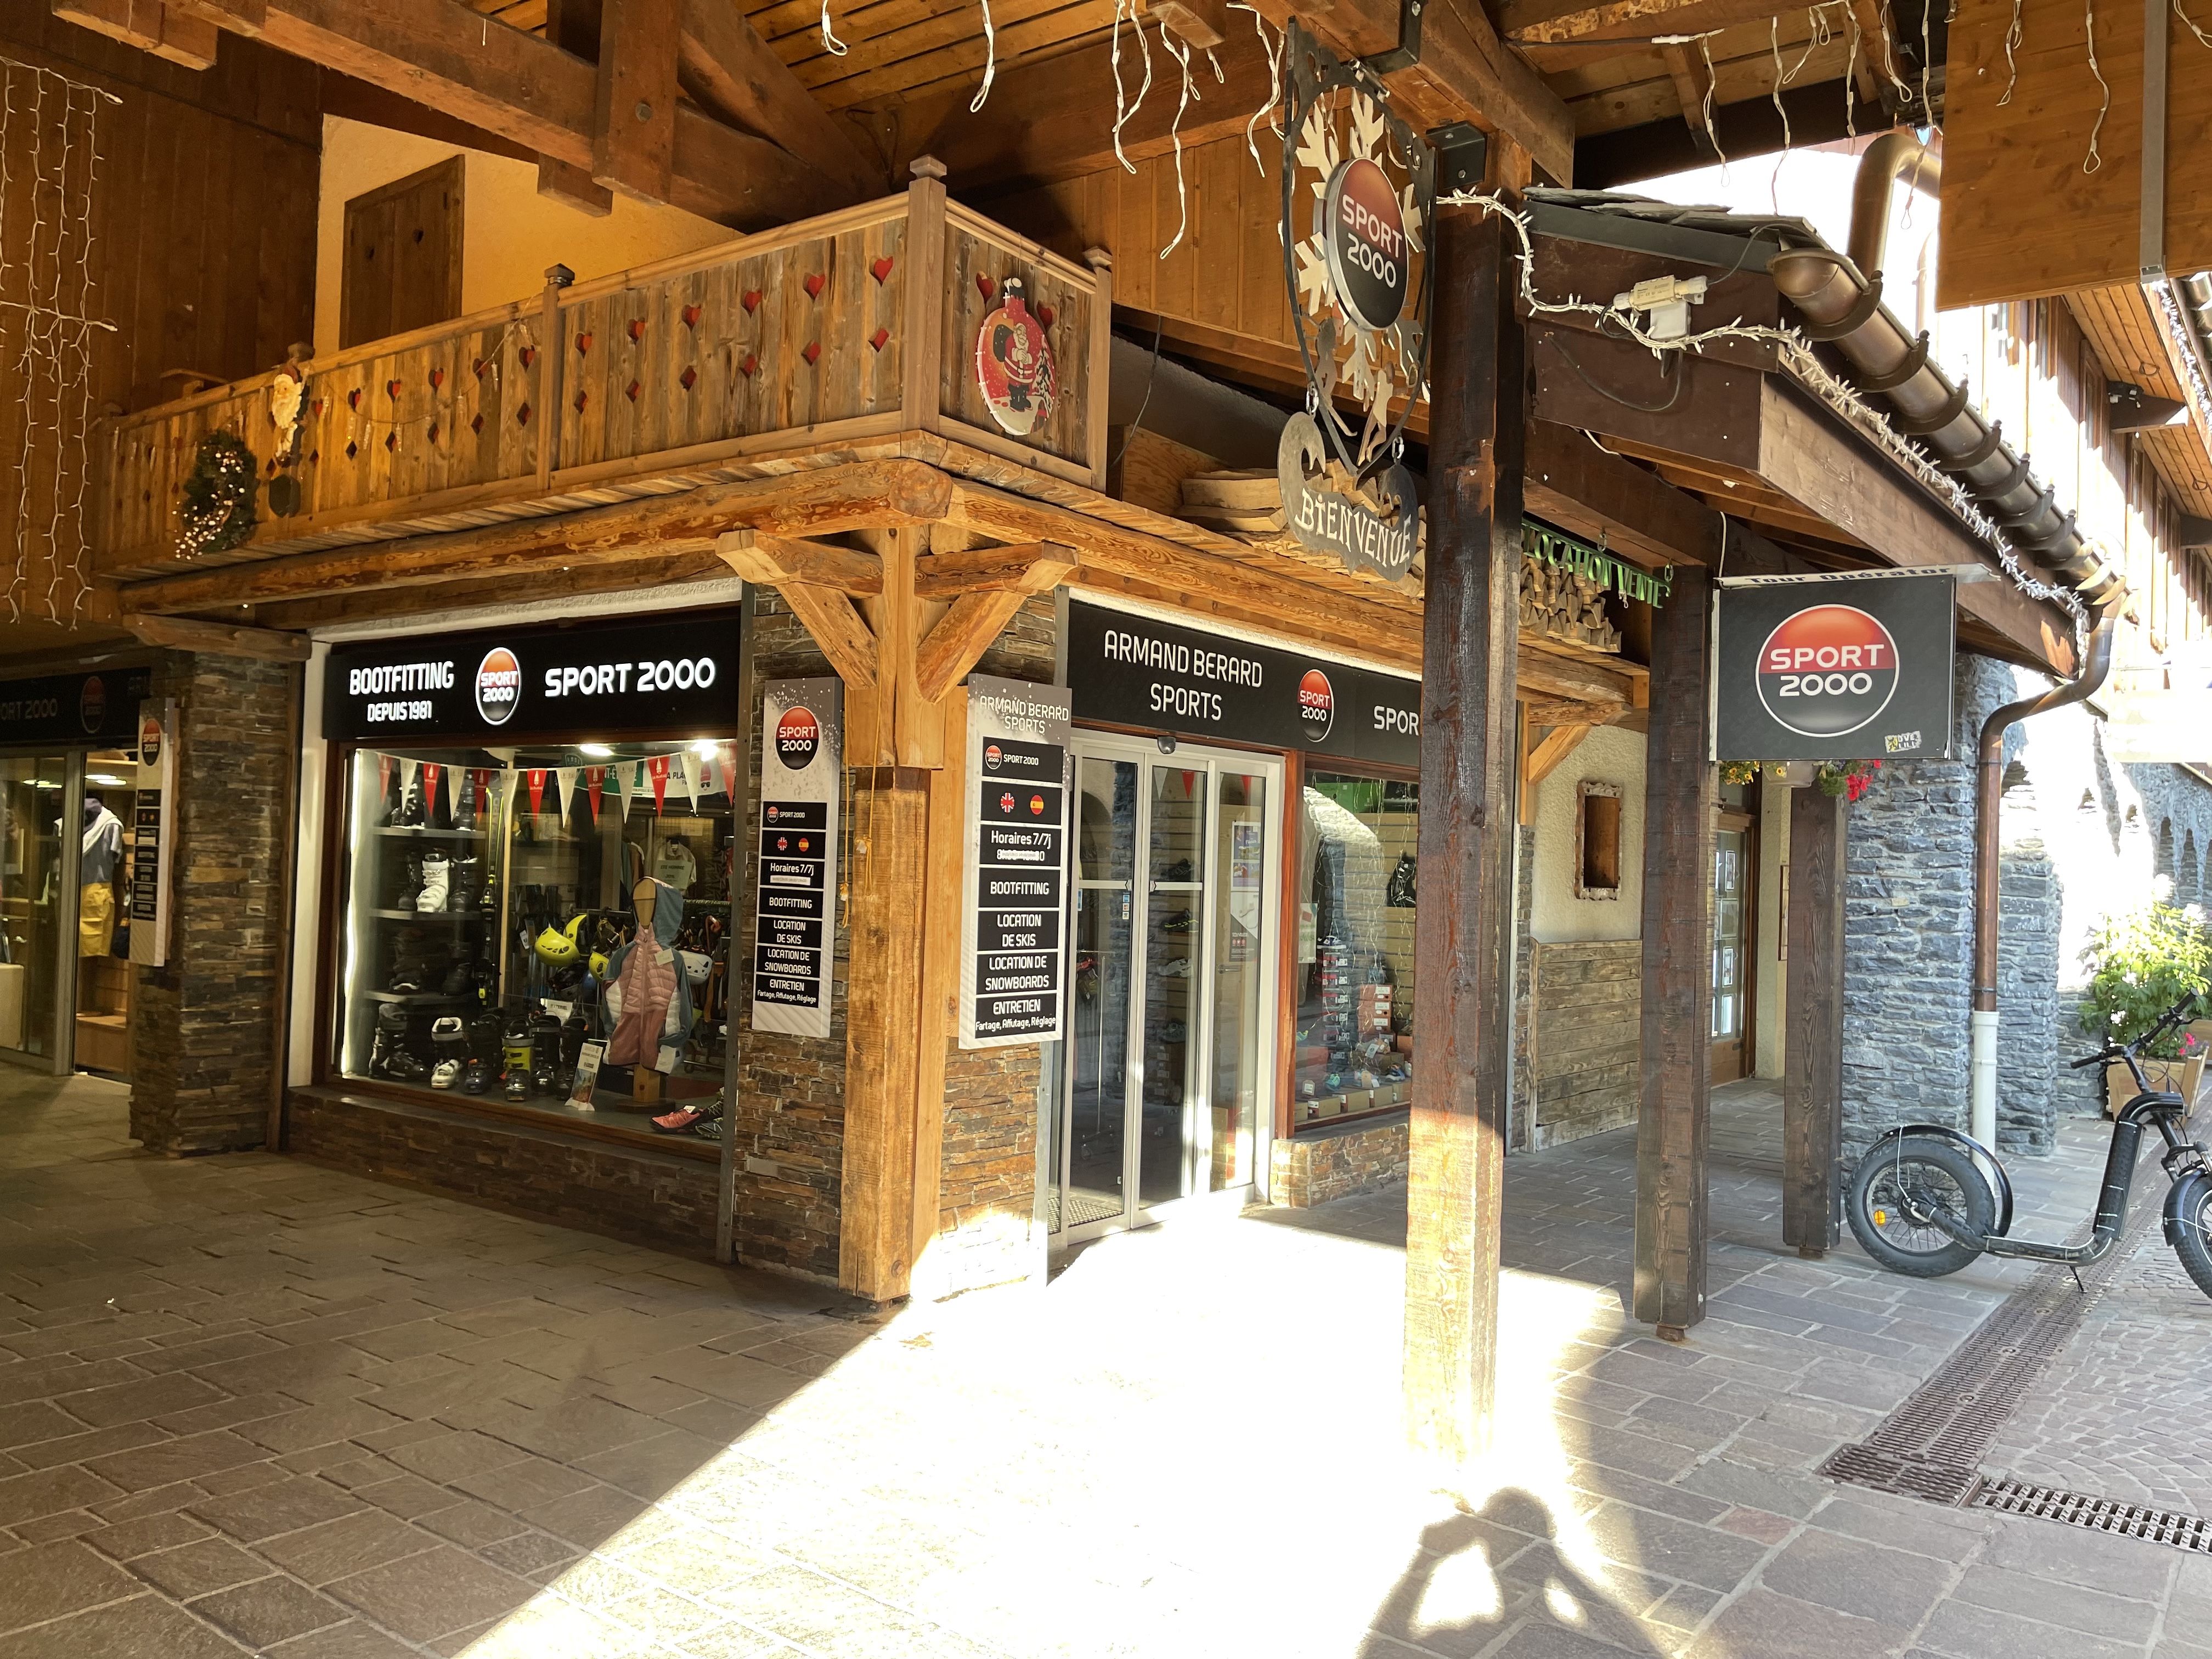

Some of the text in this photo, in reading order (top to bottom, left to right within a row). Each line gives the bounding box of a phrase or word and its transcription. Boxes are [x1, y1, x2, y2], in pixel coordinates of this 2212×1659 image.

[1342, 194, 1403, 259] SPORT
[1348, 233, 1397, 289] 2000
[1104, 629, 1262, 688] ARMAND BERARD
[1770, 644, 1884, 670] SPORT
[349, 661, 454, 695] BOOTFITTING
[480, 669, 518, 687] SPORT
[545, 657, 715, 697] SPORT 2000
[1779, 673, 1872, 697] 2000
[482, 687, 515, 703] 2000
[1150, 682, 1222, 721] SPORTS
[1299, 689, 1330, 707] SPORT
[367, 701, 432, 722] DEPUIS 1981
[980, 695, 1069, 721] ARMAND BERARD
[1301, 705, 1327, 722] 2000
[1005, 715, 1046, 734] SPORTS
[1374, 706, 1420, 736] SPOR
[779, 726, 816, 737] SPORT
[782, 740, 812, 751] 2000
[1003, 754, 1039, 765] SPORT 2000
[991, 830, 1051, 850] Horaires 7/7j
[770, 862, 814, 876] Horaires 7/7j
[990, 881, 1049, 896] BOOTFITTING
[769, 897, 812, 909] BOOTFITTING
[774, 919, 806, 931] LOCATION
[997, 913, 1041, 928] LOCATION
[776, 933, 801, 944] DE SKIS
[1002, 933, 1036, 947] DE SKIS
[768, 948, 810, 961] LOCATION DE
[989, 956, 1047, 970] LOCATION DE
[765, 962, 811, 975] SNOWBOARDS
[770, 979, 805, 991] ENTRETIEN
[985, 974, 1049, 991] SNOWBOARDS
[757, 990, 816, 1004] Fartage, Affutage, Réglage
[993, 998, 1041, 1015] ENTRETIEN
[975, 1016, 1056, 1032] Fartage, Affutage, Réglage
